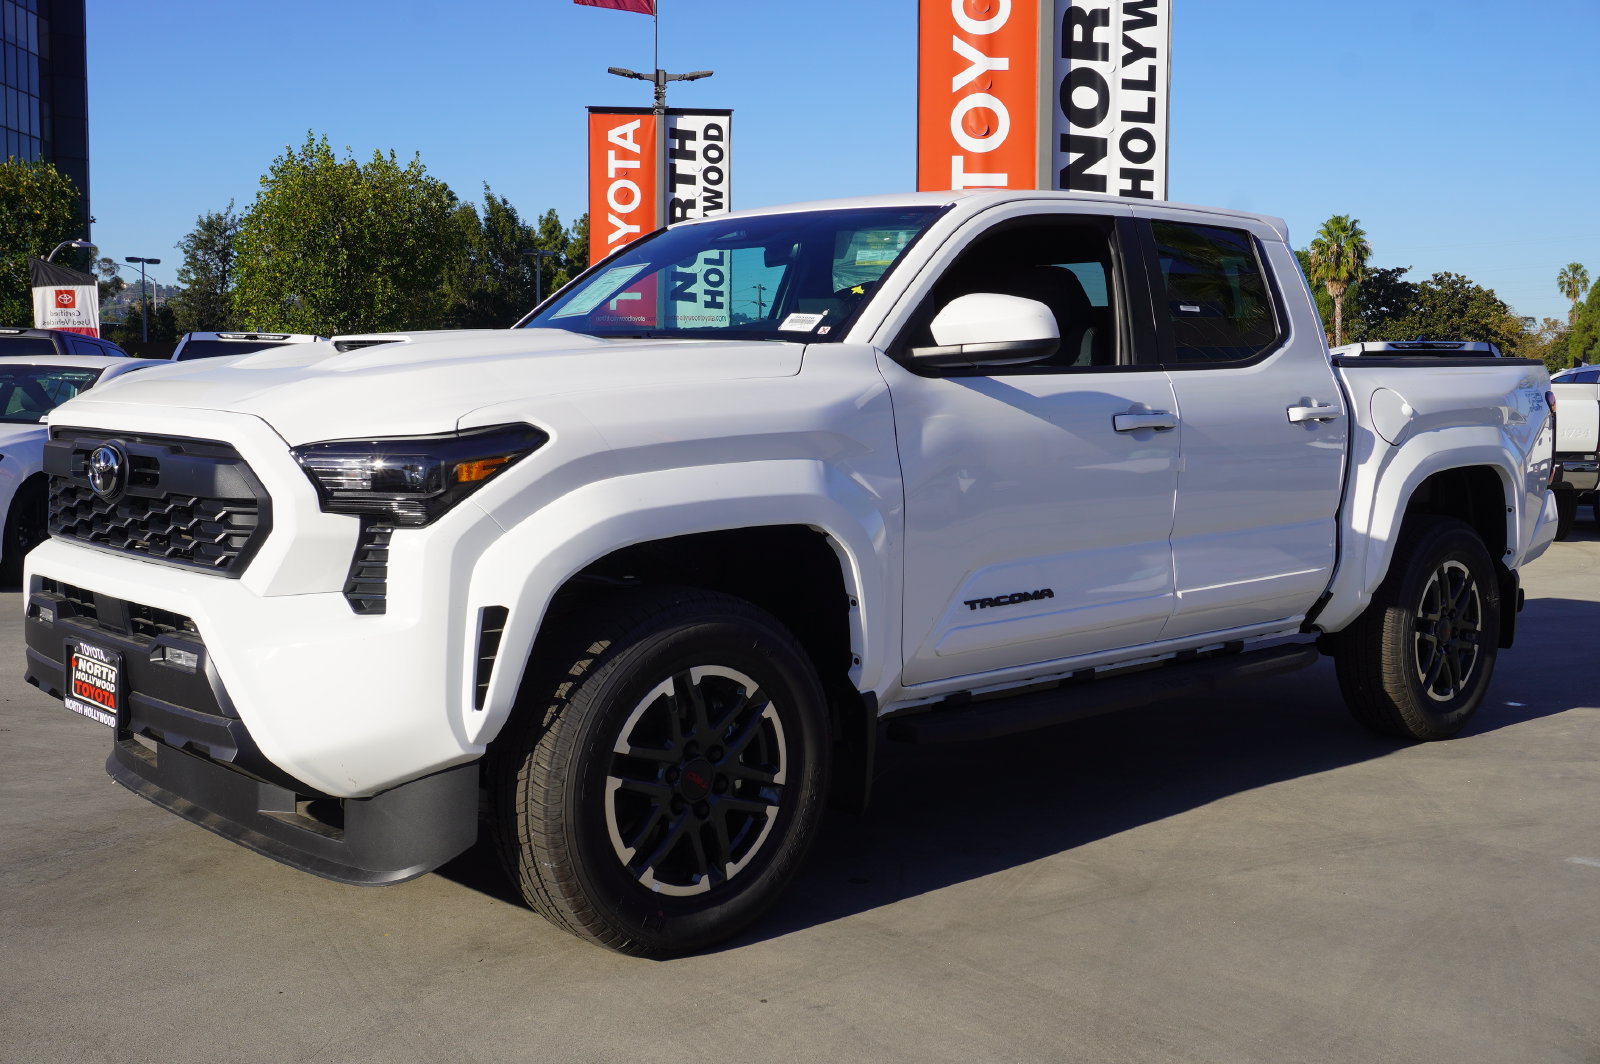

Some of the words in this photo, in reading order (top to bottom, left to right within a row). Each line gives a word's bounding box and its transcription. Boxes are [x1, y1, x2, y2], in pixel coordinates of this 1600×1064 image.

[963, 588, 1055, 611] TACOMA
[79, 642, 106, 662] TOYOTA
[75, 670, 116, 693] HOLLYWOOD
[77, 658, 116, 684] NORTH
[74, 680, 116, 709] TOYOTA
[64, 697, 83, 715] NORTH
[83, 705, 116, 728] HOLLYWOOD
